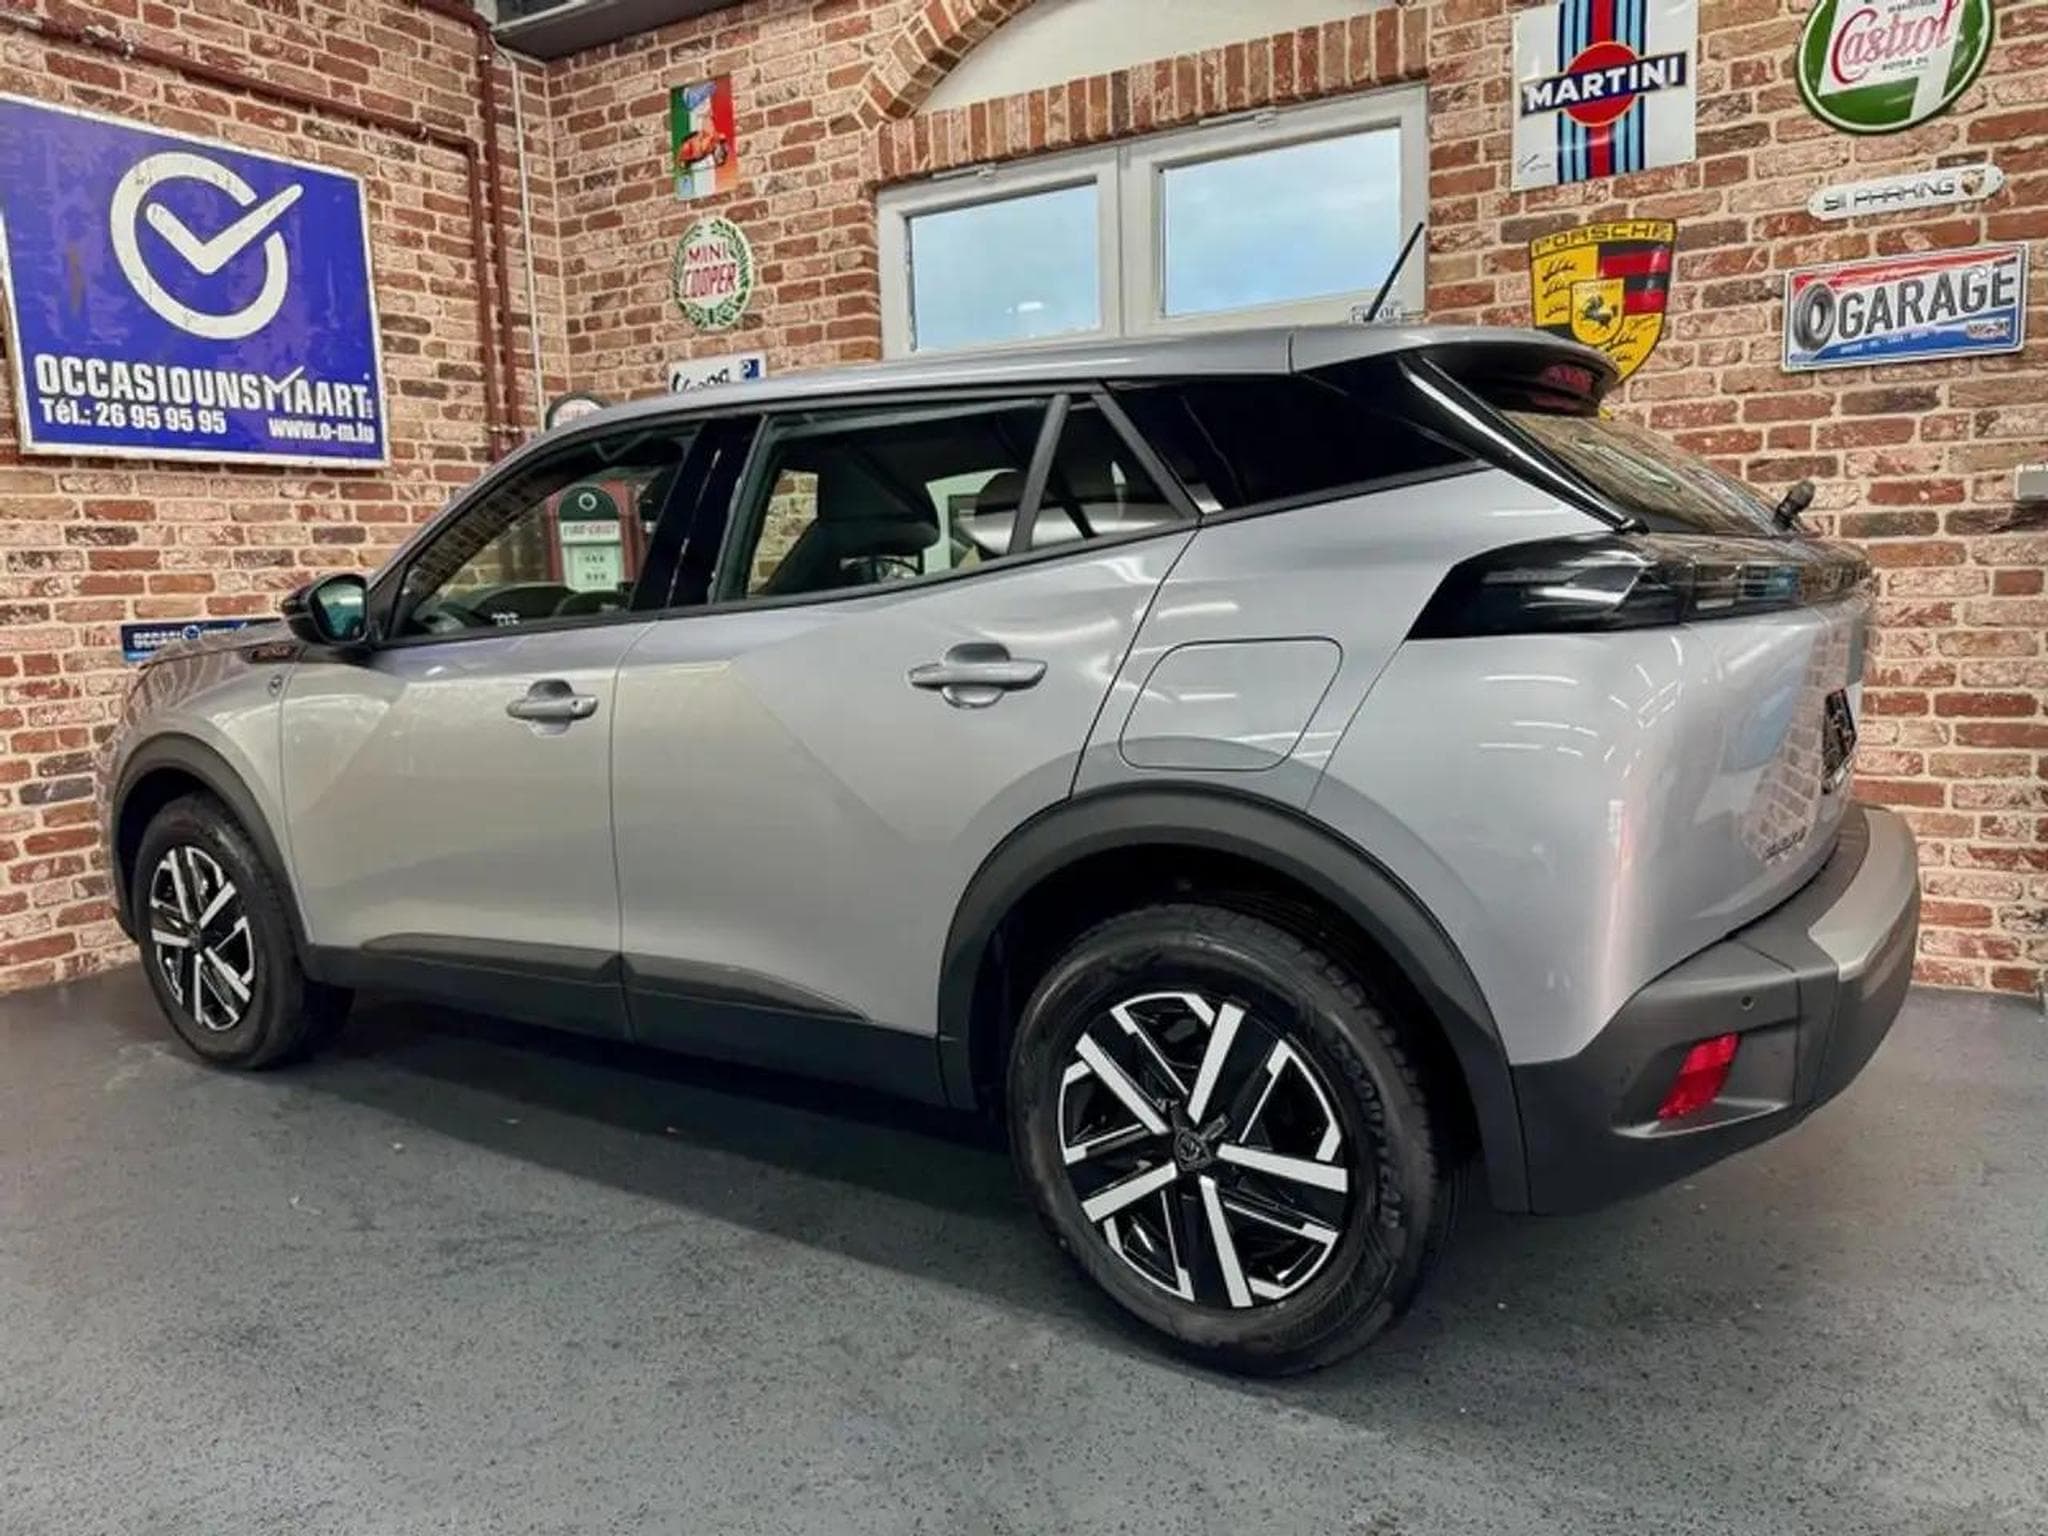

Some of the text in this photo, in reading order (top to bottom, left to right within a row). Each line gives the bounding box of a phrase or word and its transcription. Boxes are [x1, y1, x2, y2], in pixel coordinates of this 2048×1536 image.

[1832, 0, 1957, 84] Castrol
[1523, 57, 1679, 112] MARTINI
[1853, 179, 1956, 206] PARKING
[687, 242, 728, 265] MINI
[1534, 222, 1671, 254] PORSCHE
[683, 262, 737, 298] COOPER
[95, 402, 127, 428] 26
[130, 404, 161, 431] 95
[164, 407, 195, 433] 95
[198, 409, 227, 435] 95
[267, 417, 376, 444] www.o-m.lu
